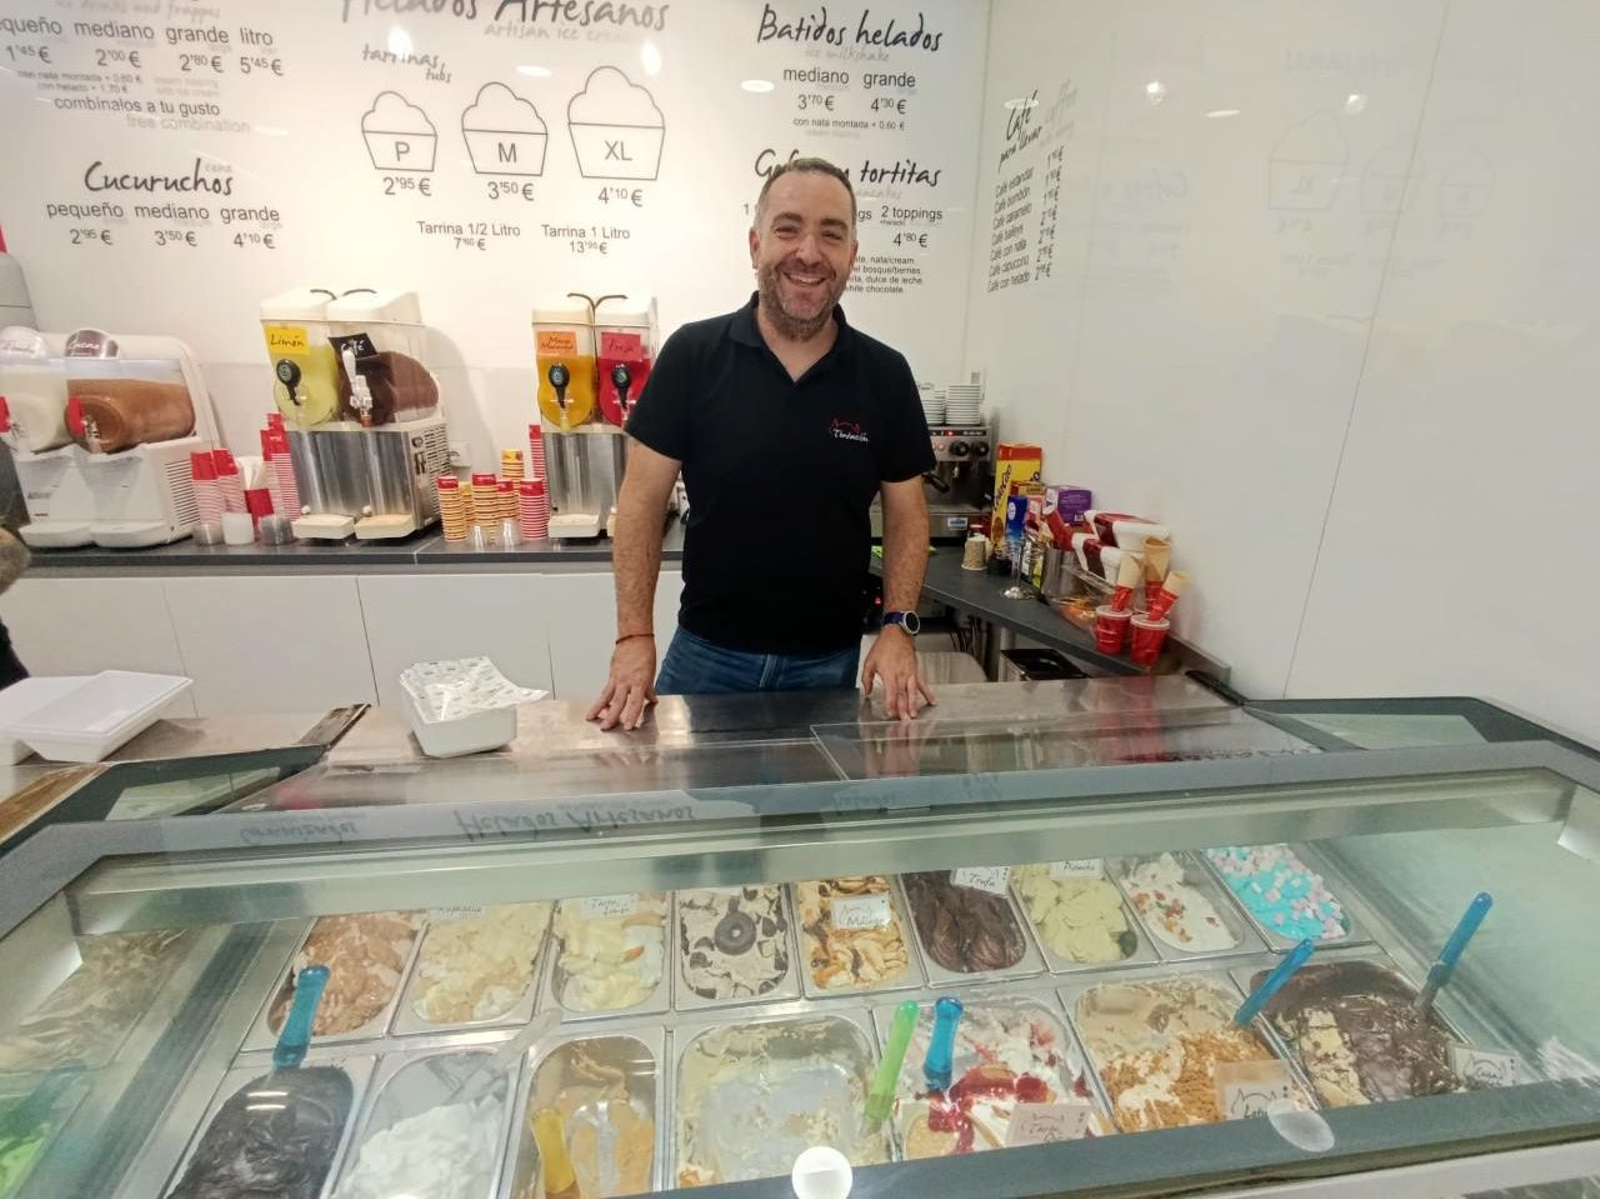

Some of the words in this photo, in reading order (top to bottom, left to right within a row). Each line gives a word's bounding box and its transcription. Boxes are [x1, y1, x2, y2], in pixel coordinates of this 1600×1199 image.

[0, 16, 62, 37] equeño
[74, 20, 155, 40] mediano
[165, 26, 229, 45] grande
[239, 27, 273, 46] litro
[757, 3, 846, 46] Batidos
[855, 9, 942, 52] helados
[783, 67, 850, 86] mediano
[862, 72, 916, 89] grande
[146, 102, 156, 113] a
[179, 101, 220, 118] gusto
[394, 140, 411, 161] P
[498, 142, 518, 164] M
[604, 140, 633, 162] XL
[83, 157, 234, 196] Cucuruchos
[858, 159, 943, 188] tortitas
[46, 201, 124, 219] pequeño
[133, 203, 210, 220] mediano
[219, 206, 280, 224] grande
[880, 204, 890, 219] 2
[893, 206, 943, 223] toppings
[416, 220, 463, 236] Tarrina
[468, 223, 488, 236] 1/2
[491, 224, 521, 237] Litro
[541, 224, 587, 239] Tarrina
[602, 227, 630, 241] Litro
